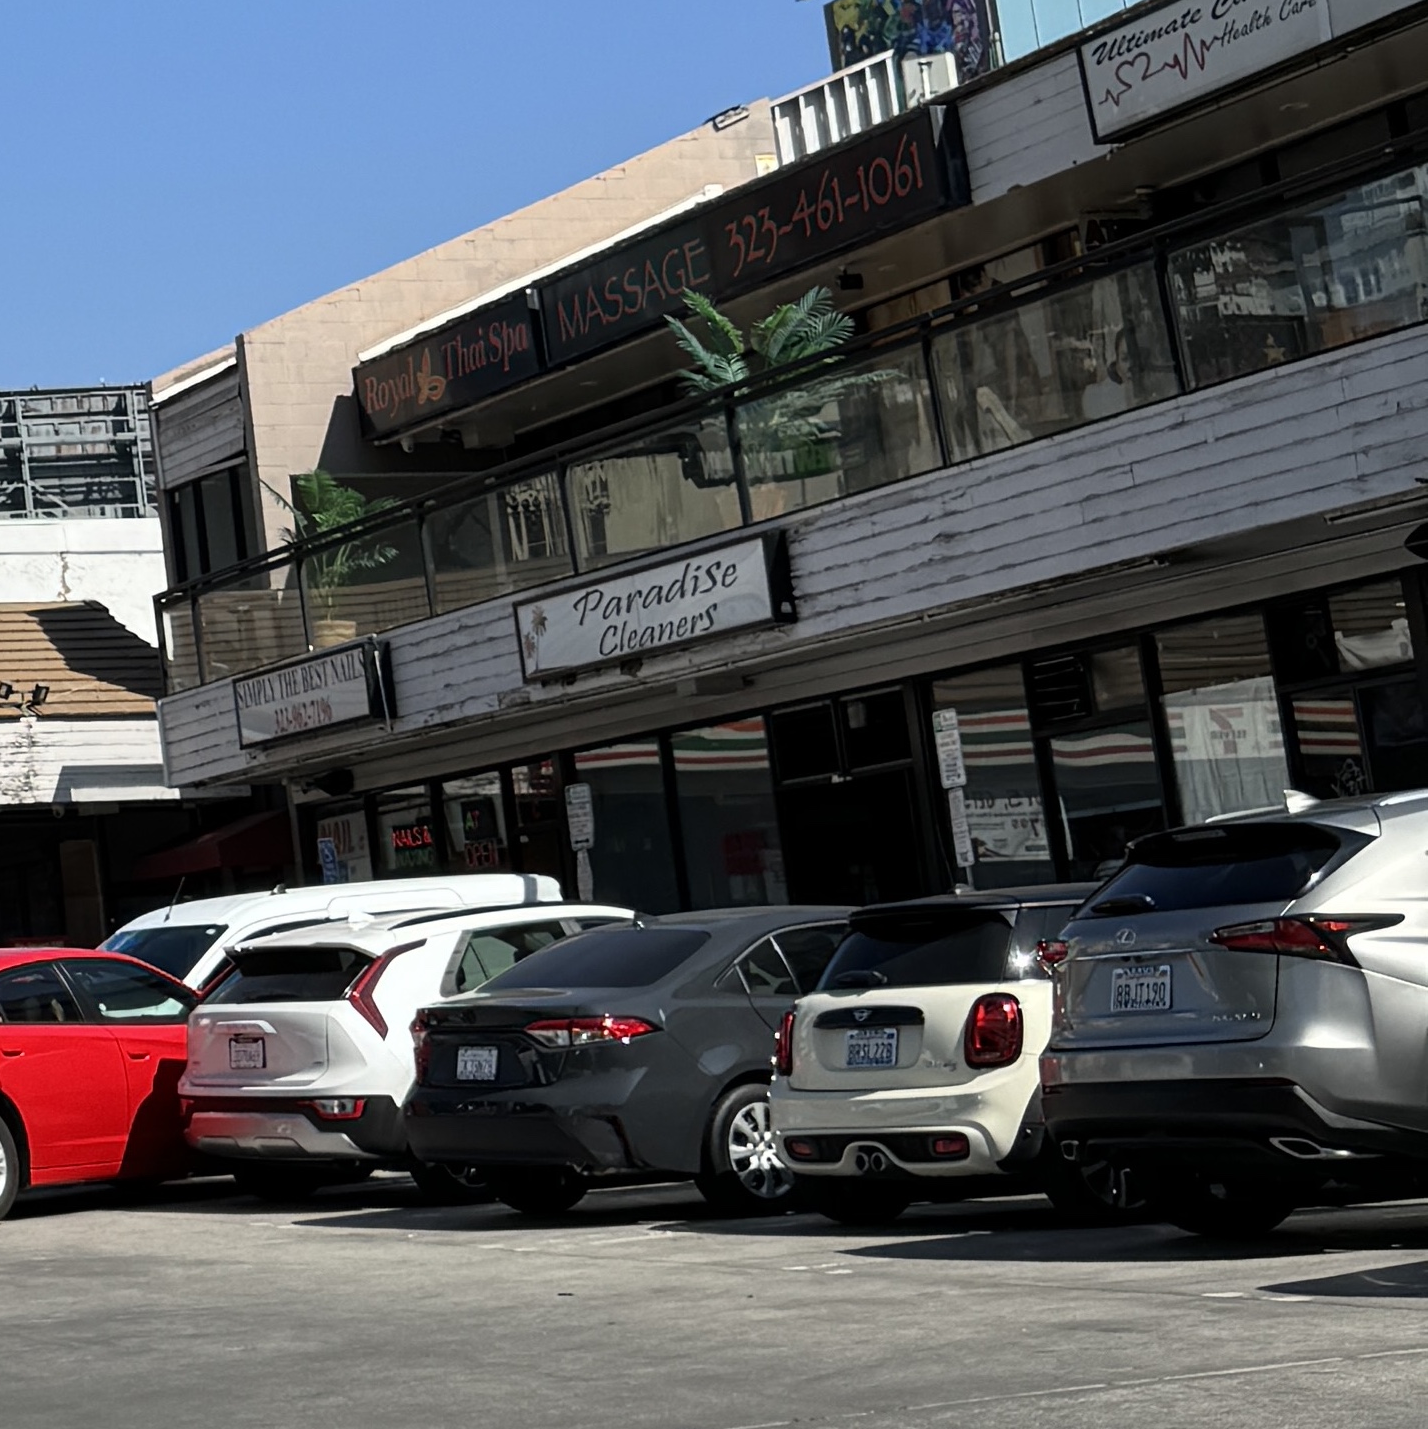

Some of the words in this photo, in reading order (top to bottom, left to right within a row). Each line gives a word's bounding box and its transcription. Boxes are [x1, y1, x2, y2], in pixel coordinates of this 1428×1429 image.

[1091, 7, 1203, 66] Ultimate
[1218, 6, 1273, 47] Health
[556, 237, 711, 342] MASSAGE
[724, 133, 924, 278] 323-461-1061
[364, 356, 415, 418] Royal
[441, 326, 487, 380] Thai
[488, 320, 528, 372] Spa
[573, 561, 738, 626] Paradise
[599, 602, 718, 657] Cleaners
[235, 676, 276, 709] SIMPLY
[278, 669, 301, 700] THE
[300, 660, 329, 693] BEST
[330, 650, 365, 685] NAILS
